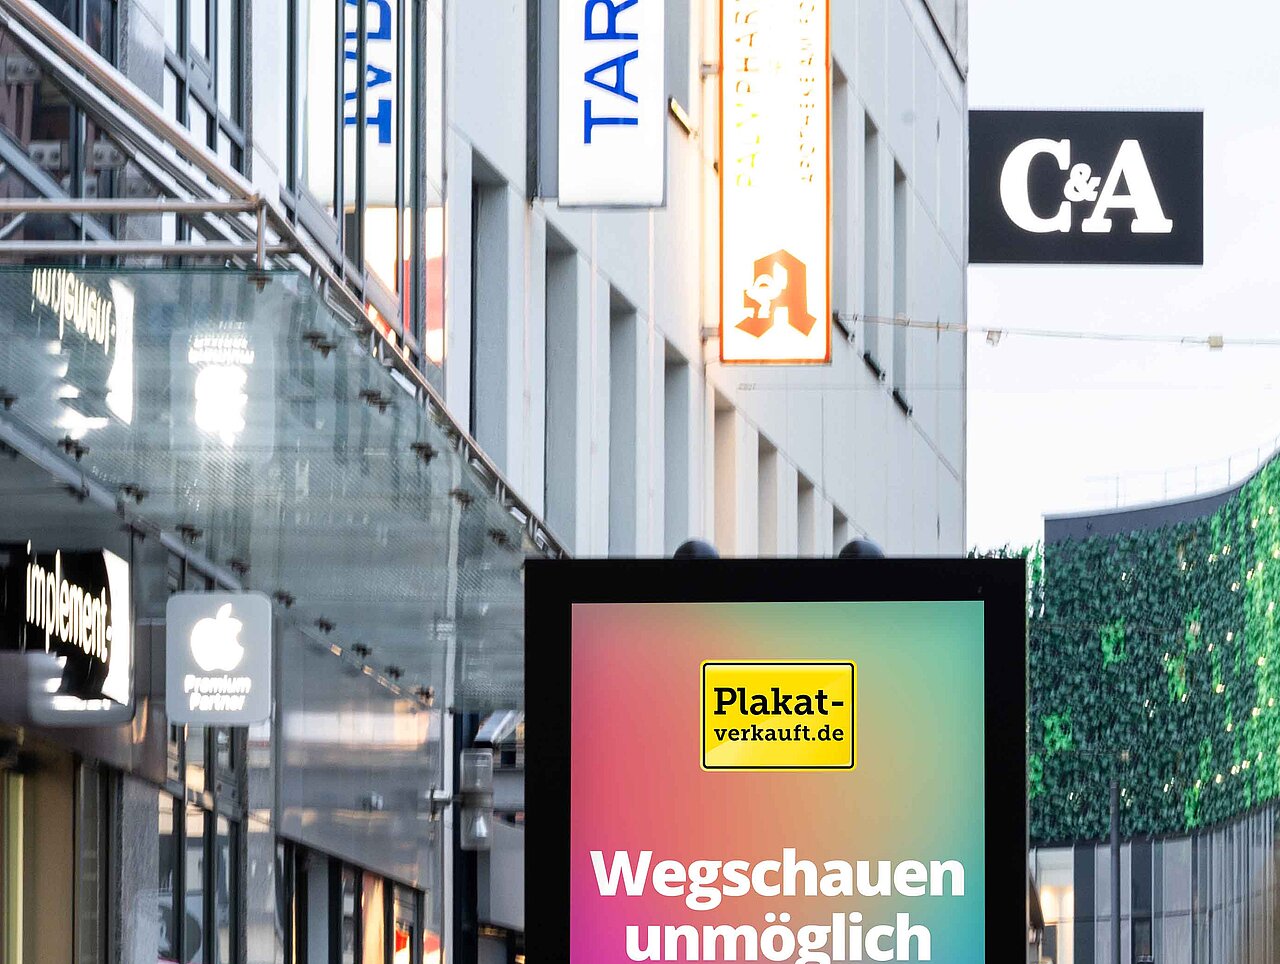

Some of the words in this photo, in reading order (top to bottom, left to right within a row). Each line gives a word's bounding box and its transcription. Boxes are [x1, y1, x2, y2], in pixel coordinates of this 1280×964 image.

[1000, 138, 1174, 233] C&A
[184, 674, 252, 694] Premium
[713, 687, 844, 715] Plakat-
[713, 724, 844, 741] verkauft.de
[589, 847, 965, 911] Wegschauen
